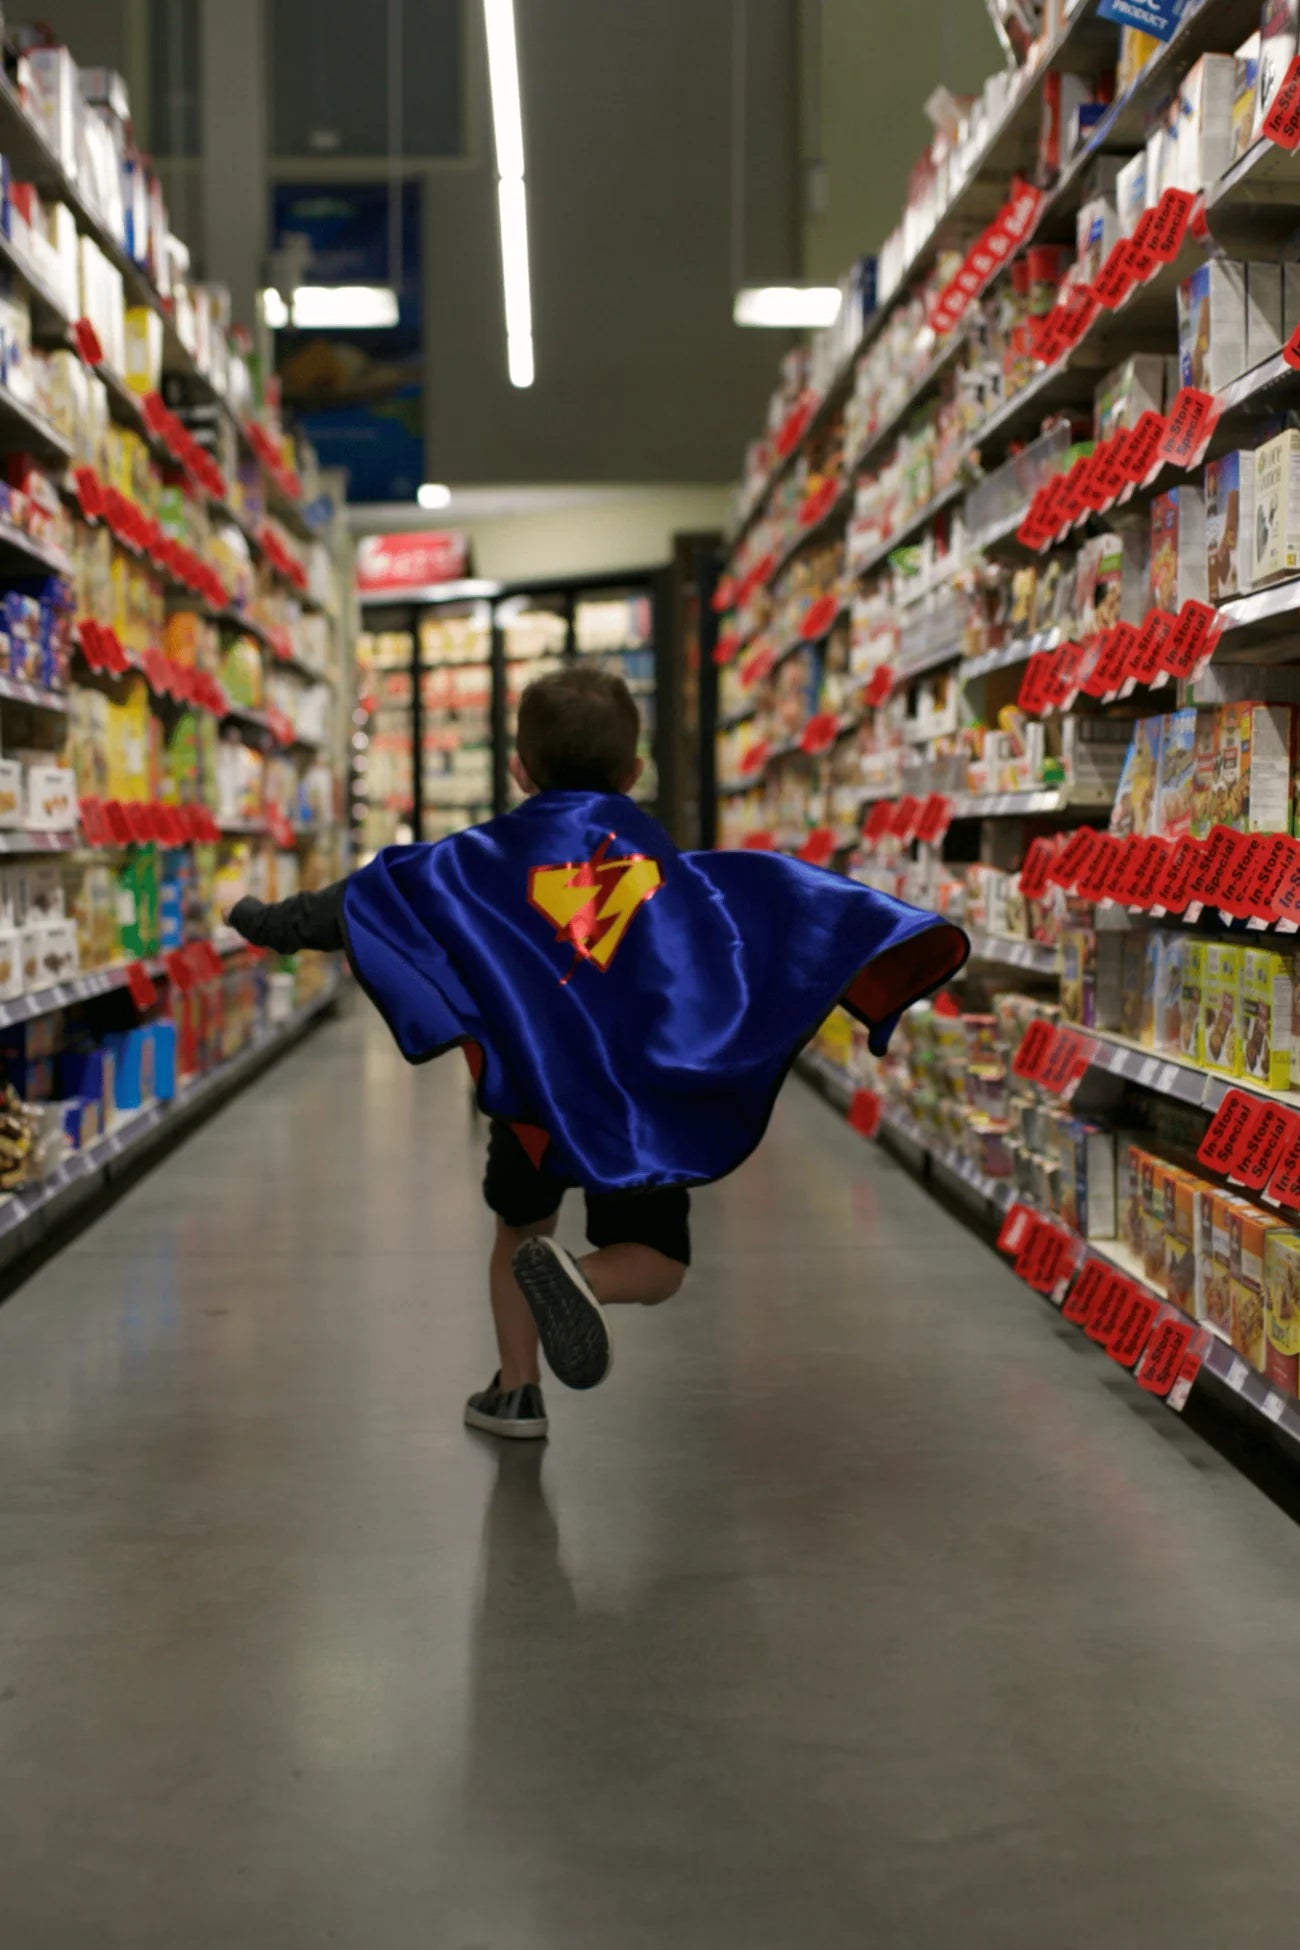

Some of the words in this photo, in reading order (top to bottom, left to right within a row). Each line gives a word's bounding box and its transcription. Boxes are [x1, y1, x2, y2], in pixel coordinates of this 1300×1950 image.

[1111, 0, 1169, 30] PRODUCT
[1148, 193, 1175, 253] In-Store
[1160, 199, 1188, 253] Special
[1120, 418, 1153, 473] In-Store
[1132, 424, 1162, 474] Special
[1163, 395, 1192, 453] In-Store
[1176, 401, 1204, 456] Special
[1129, 615, 1161, 670] In-Store
[1142, 623, 1172, 672] Special
[1165, 607, 1195, 664] In-Store
[1177, 613, 1206, 668] Special
[1127, 843, 1157, 896] In-Store
[1160, 843, 1190, 899] In-Store
[1191, 832, 1224, 892] In-Store
[1204, 838, 1236, 896] Special
[1222, 840, 1259, 900] In-Store
[1249, 840, 1284, 905] In-Store
[1203, 1098, 1239, 1157] In-Store
[1217, 1104, 1250, 1163] Special
[1237, 1110, 1273, 1174] In-Store
[1252, 1117, 1287, 1178] Special
[1143, 1326, 1173, 1381] In-Store
[1156, 1331, 1185, 1384] Special
